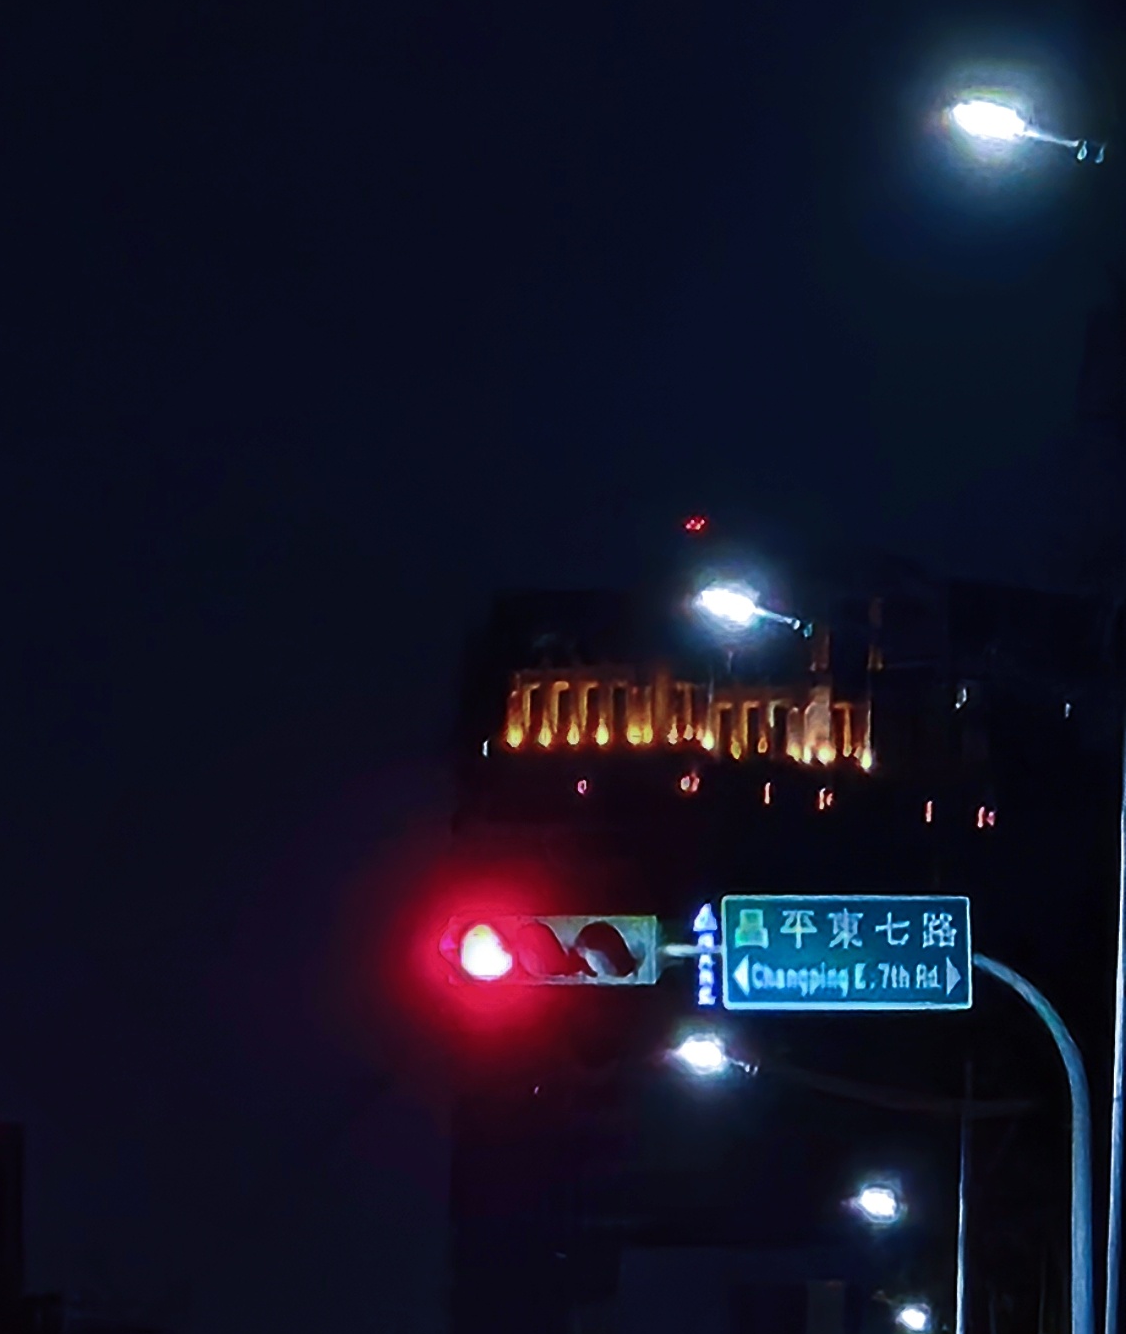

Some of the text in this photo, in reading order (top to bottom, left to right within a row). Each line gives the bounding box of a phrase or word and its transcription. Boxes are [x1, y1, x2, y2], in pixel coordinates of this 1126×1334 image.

[734, 907, 958, 950] 昌平東七路
[751, 961, 849, 997] Changping
[878, 963, 910, 989] 7th
